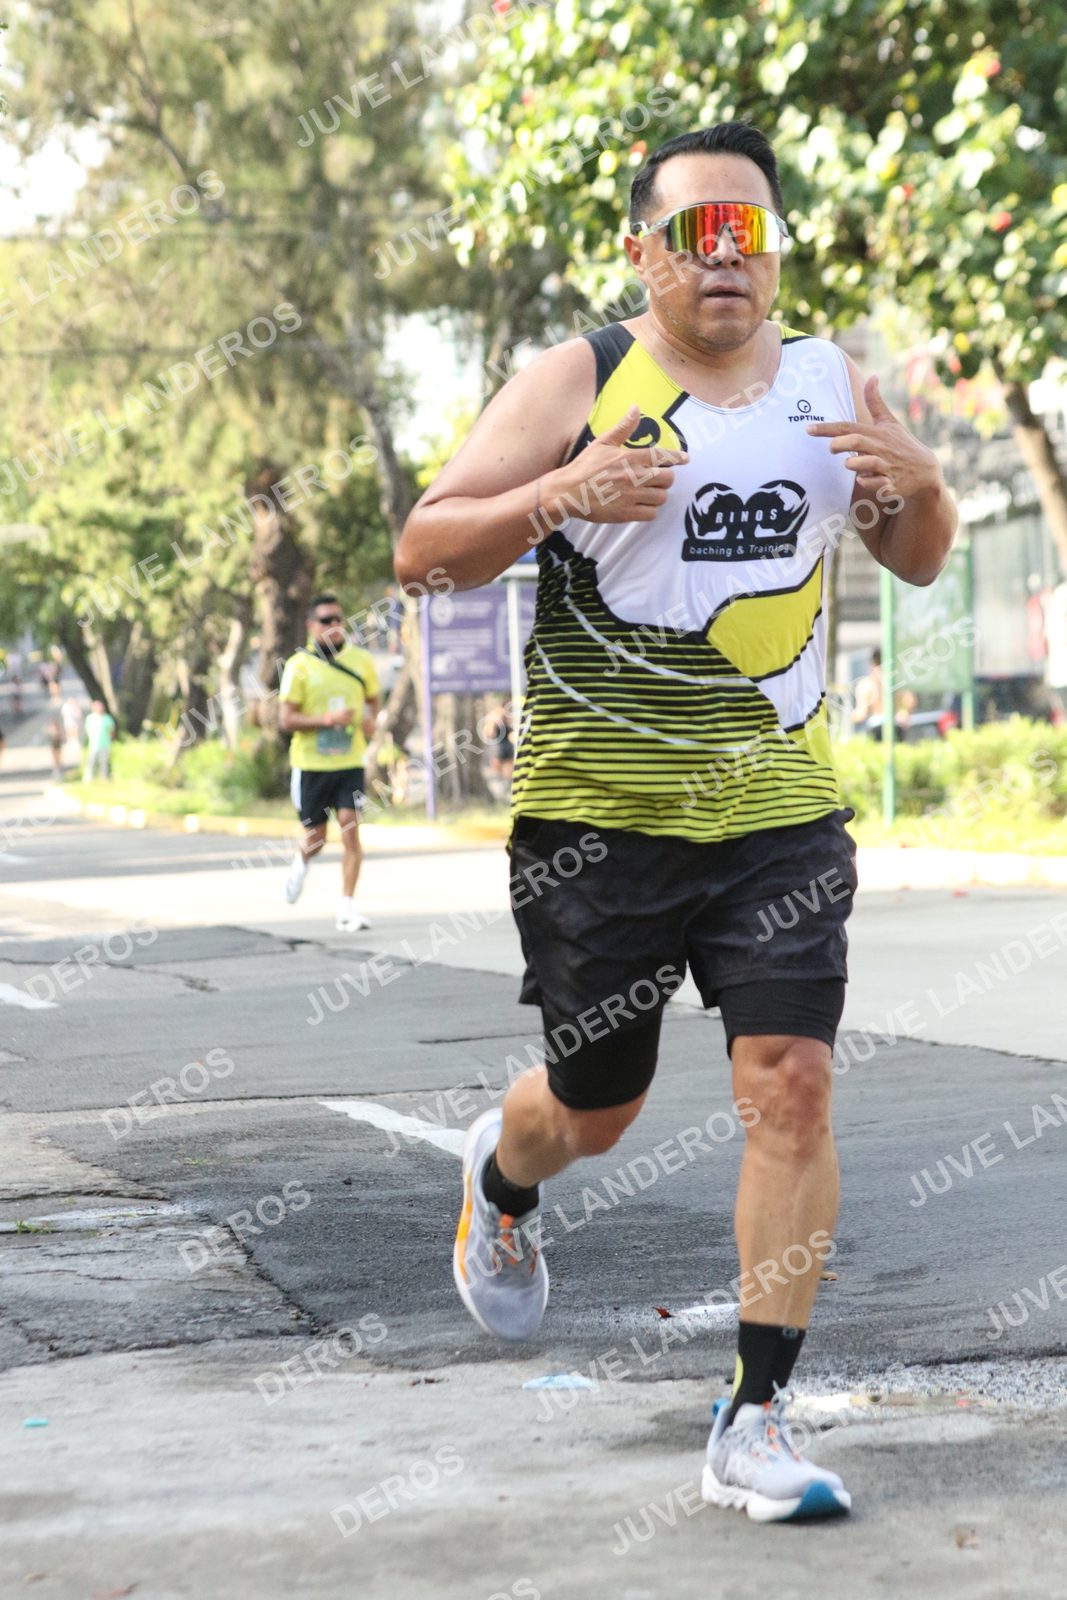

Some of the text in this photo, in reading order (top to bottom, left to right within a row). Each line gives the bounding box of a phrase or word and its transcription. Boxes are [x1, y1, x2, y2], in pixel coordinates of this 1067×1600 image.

[788, 414, 825, 423] TOPTIME
[715, 508, 778, 524] RINOS
[736, 545, 745, 555] &
[749, 543, 789, 555] Training
